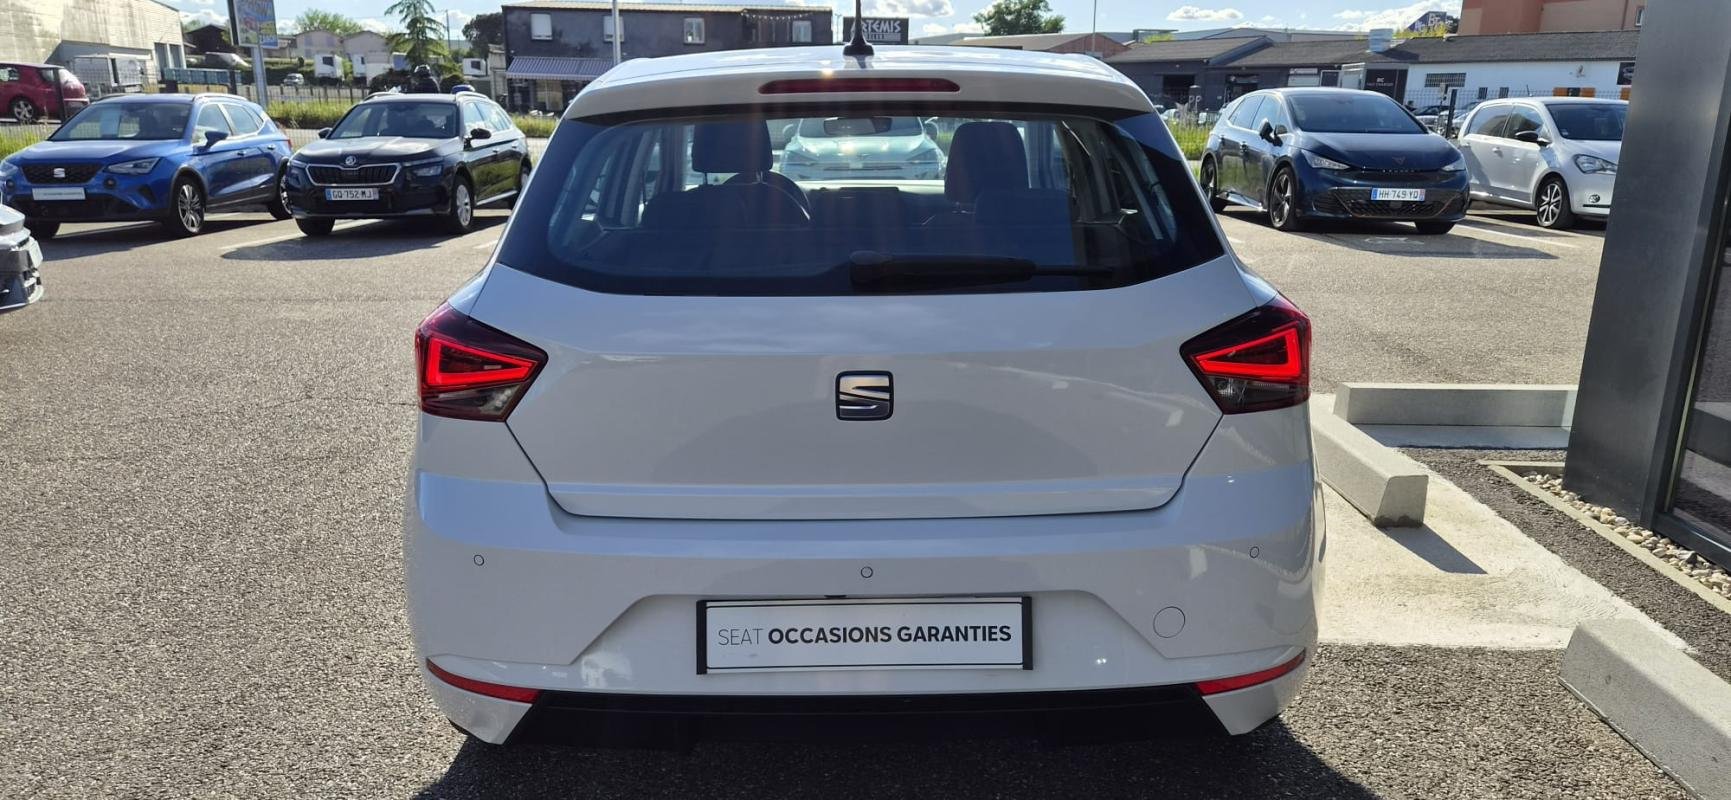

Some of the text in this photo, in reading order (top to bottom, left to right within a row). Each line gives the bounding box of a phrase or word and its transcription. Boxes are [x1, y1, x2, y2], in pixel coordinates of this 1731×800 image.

[718, 625, 1012, 646] SEAT OCCASIONS GARANTIES
